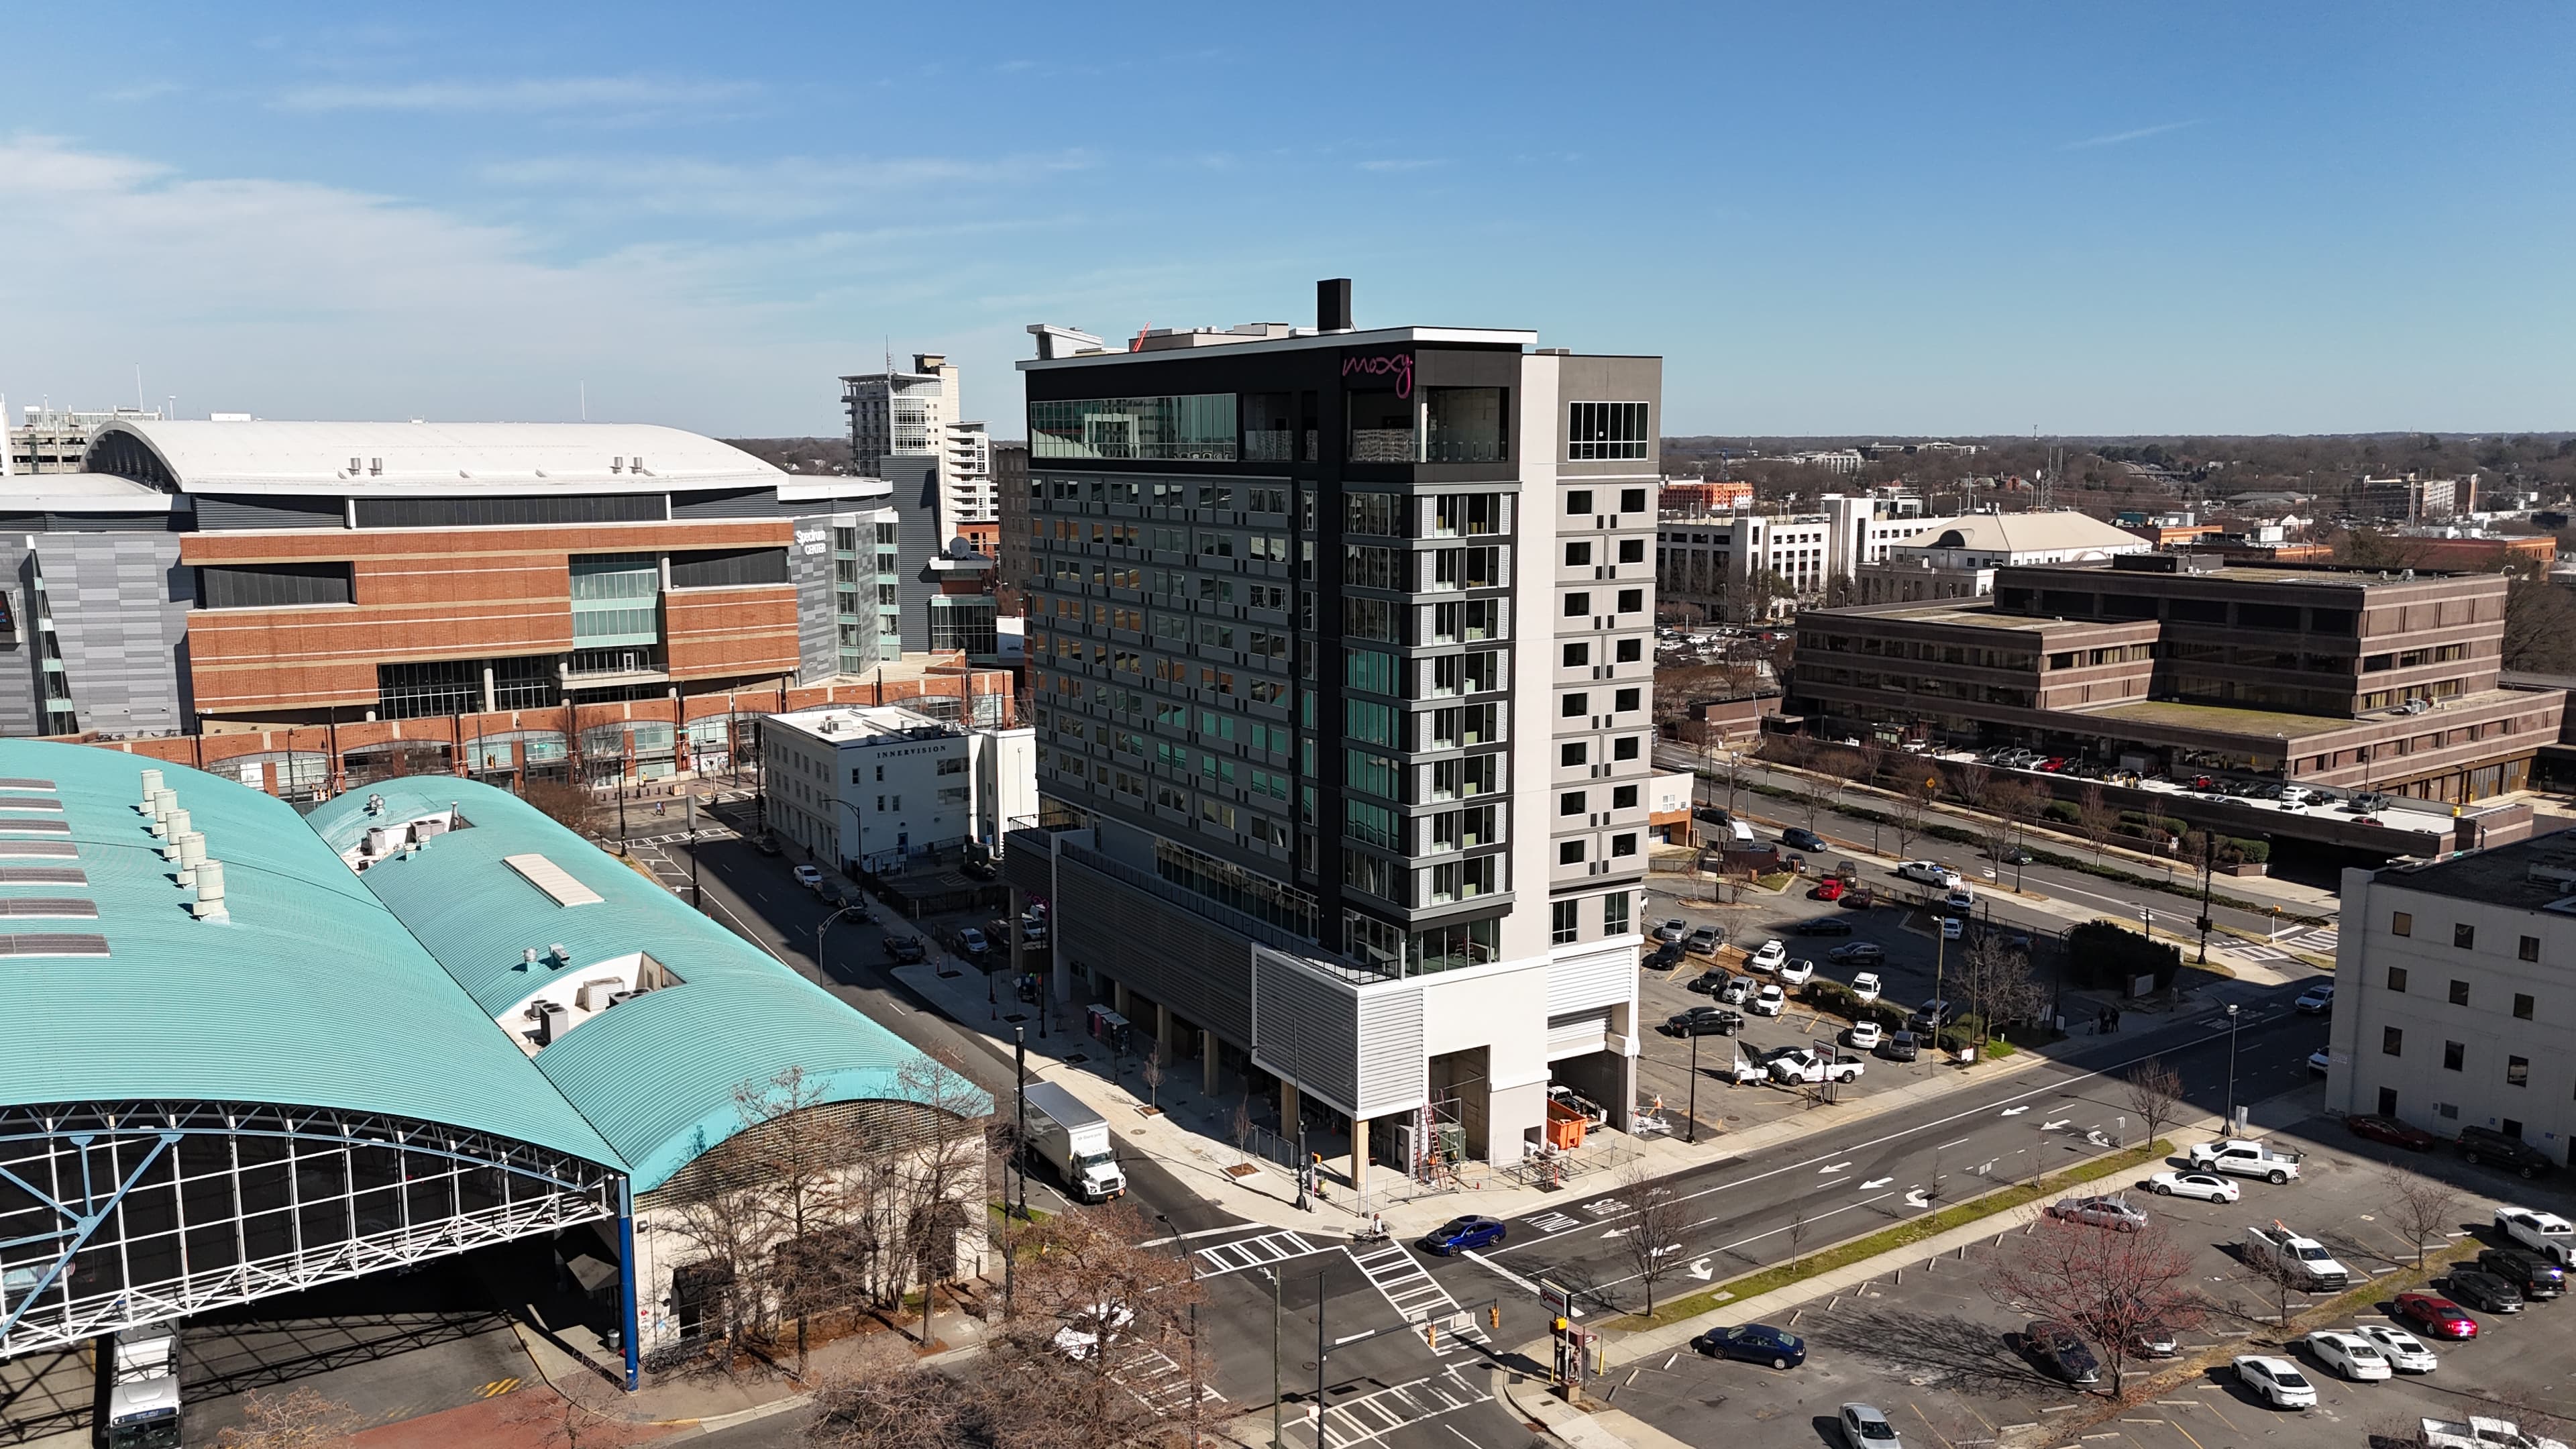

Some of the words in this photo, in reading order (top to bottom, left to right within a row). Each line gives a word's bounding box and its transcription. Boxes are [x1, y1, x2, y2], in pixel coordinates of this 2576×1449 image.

[1342, 354, 1412, 399] moxy
[796, 529, 826, 545] Spectrum
[805, 543, 826, 555] CENTER
[877, 745, 946, 758] INNERVISION
[1582, 1197, 1631, 1216] BUS
[1521, 1212, 1580, 1232] ONLY
